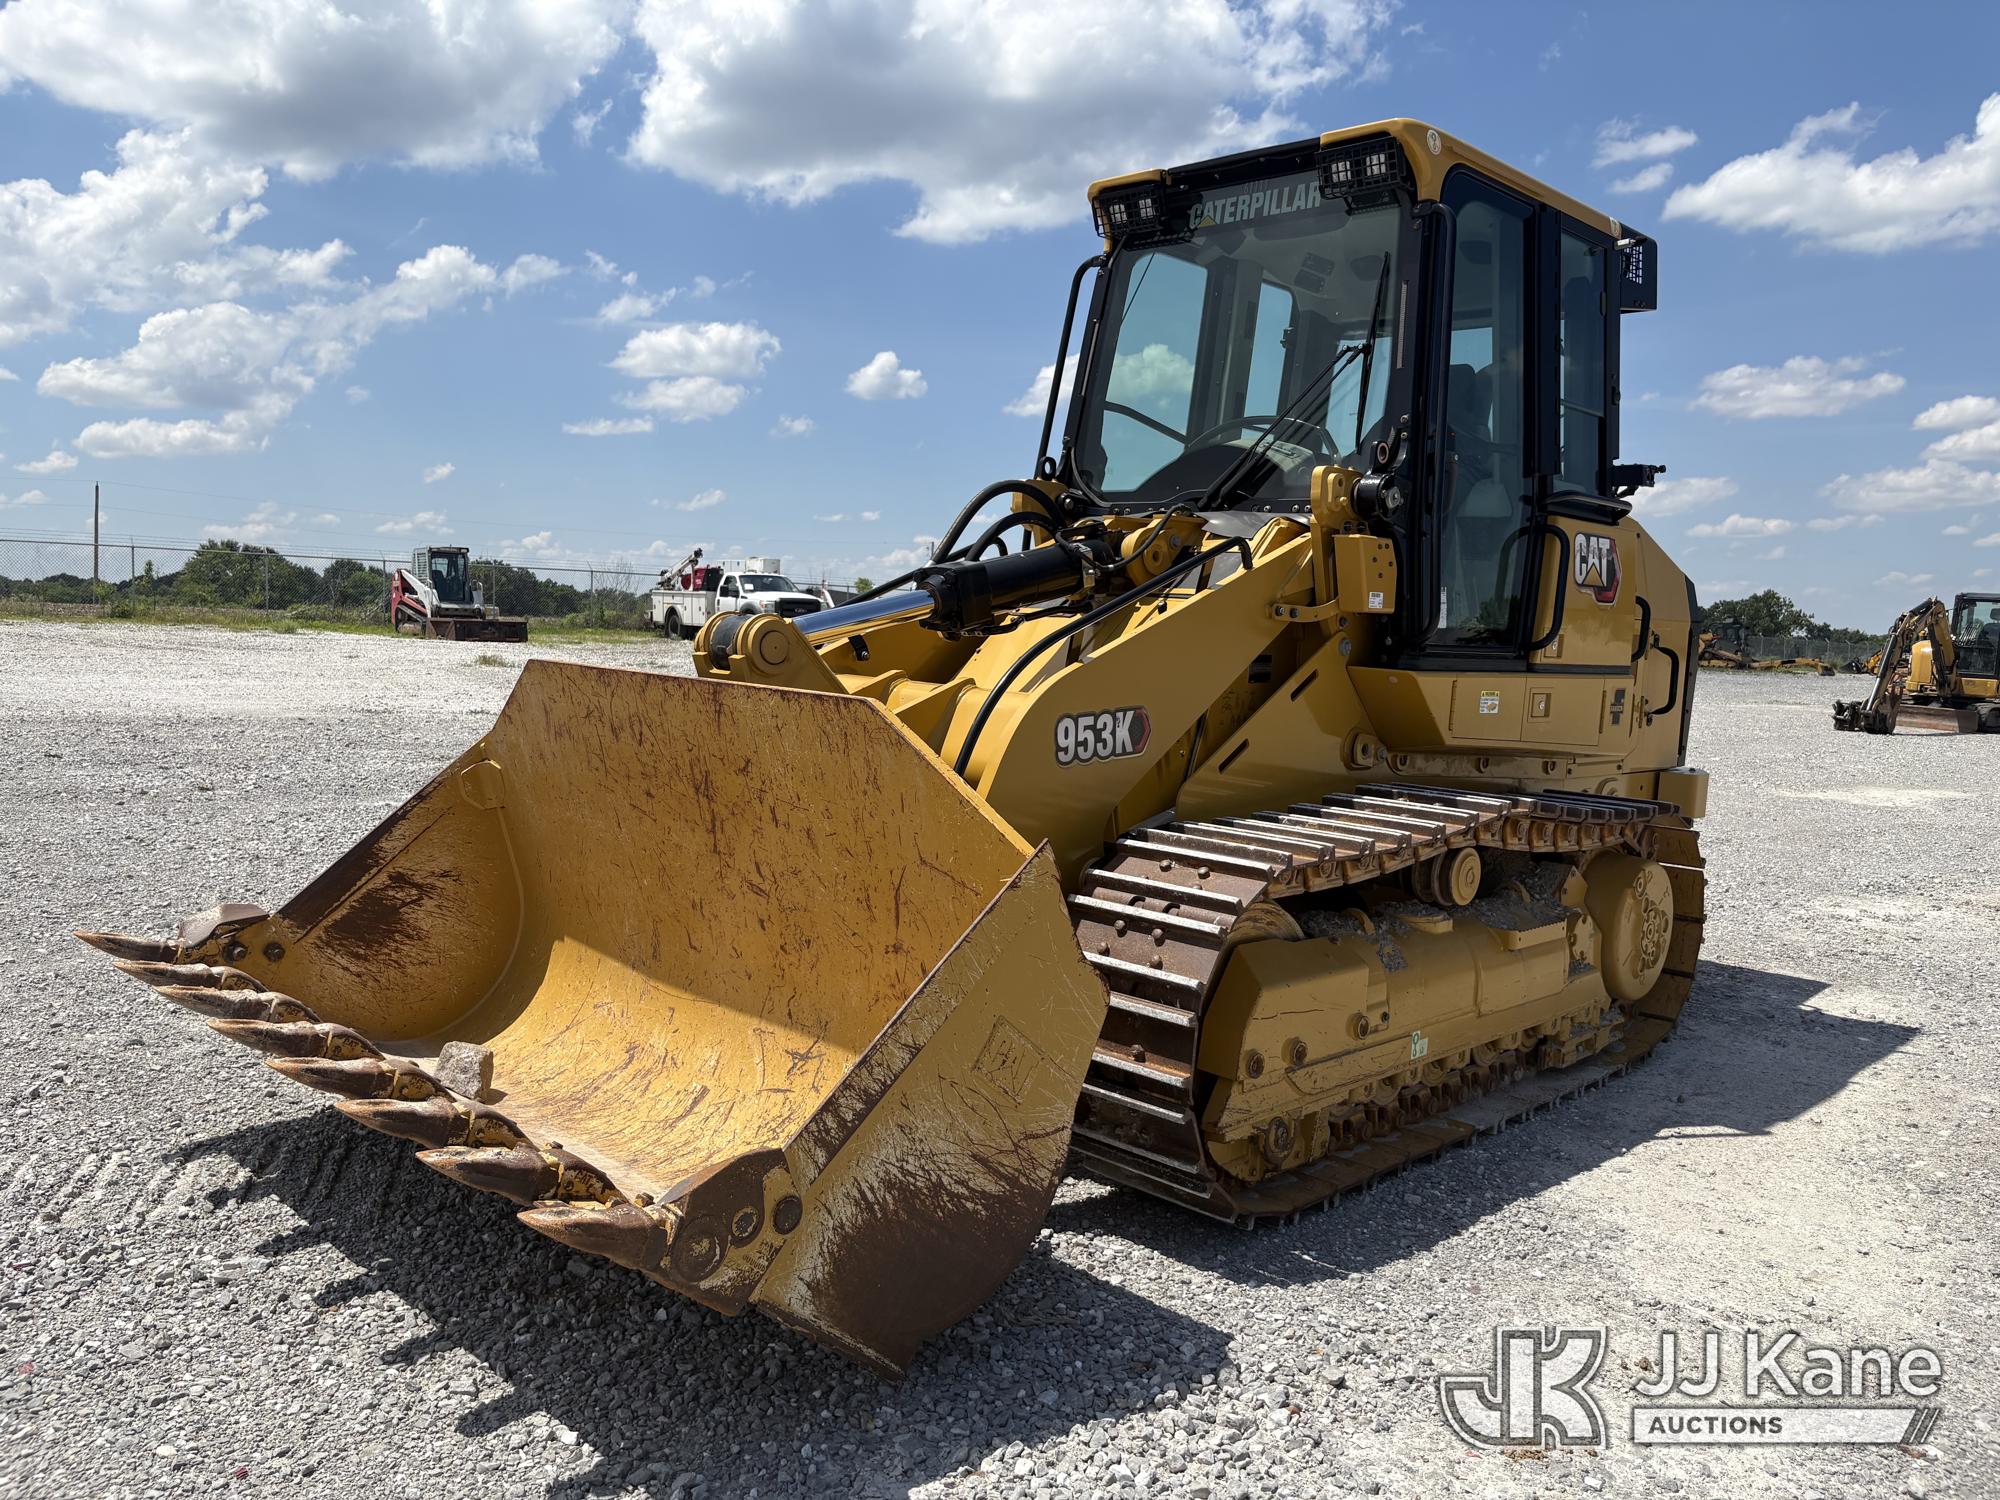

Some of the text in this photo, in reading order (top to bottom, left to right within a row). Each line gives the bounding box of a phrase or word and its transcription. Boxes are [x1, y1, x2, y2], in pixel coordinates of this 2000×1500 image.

[1189, 181, 1322, 229] CATERPILLAR
[1575, 533, 1611, 587] CAT
[1057, 710, 1135, 763] 953K
